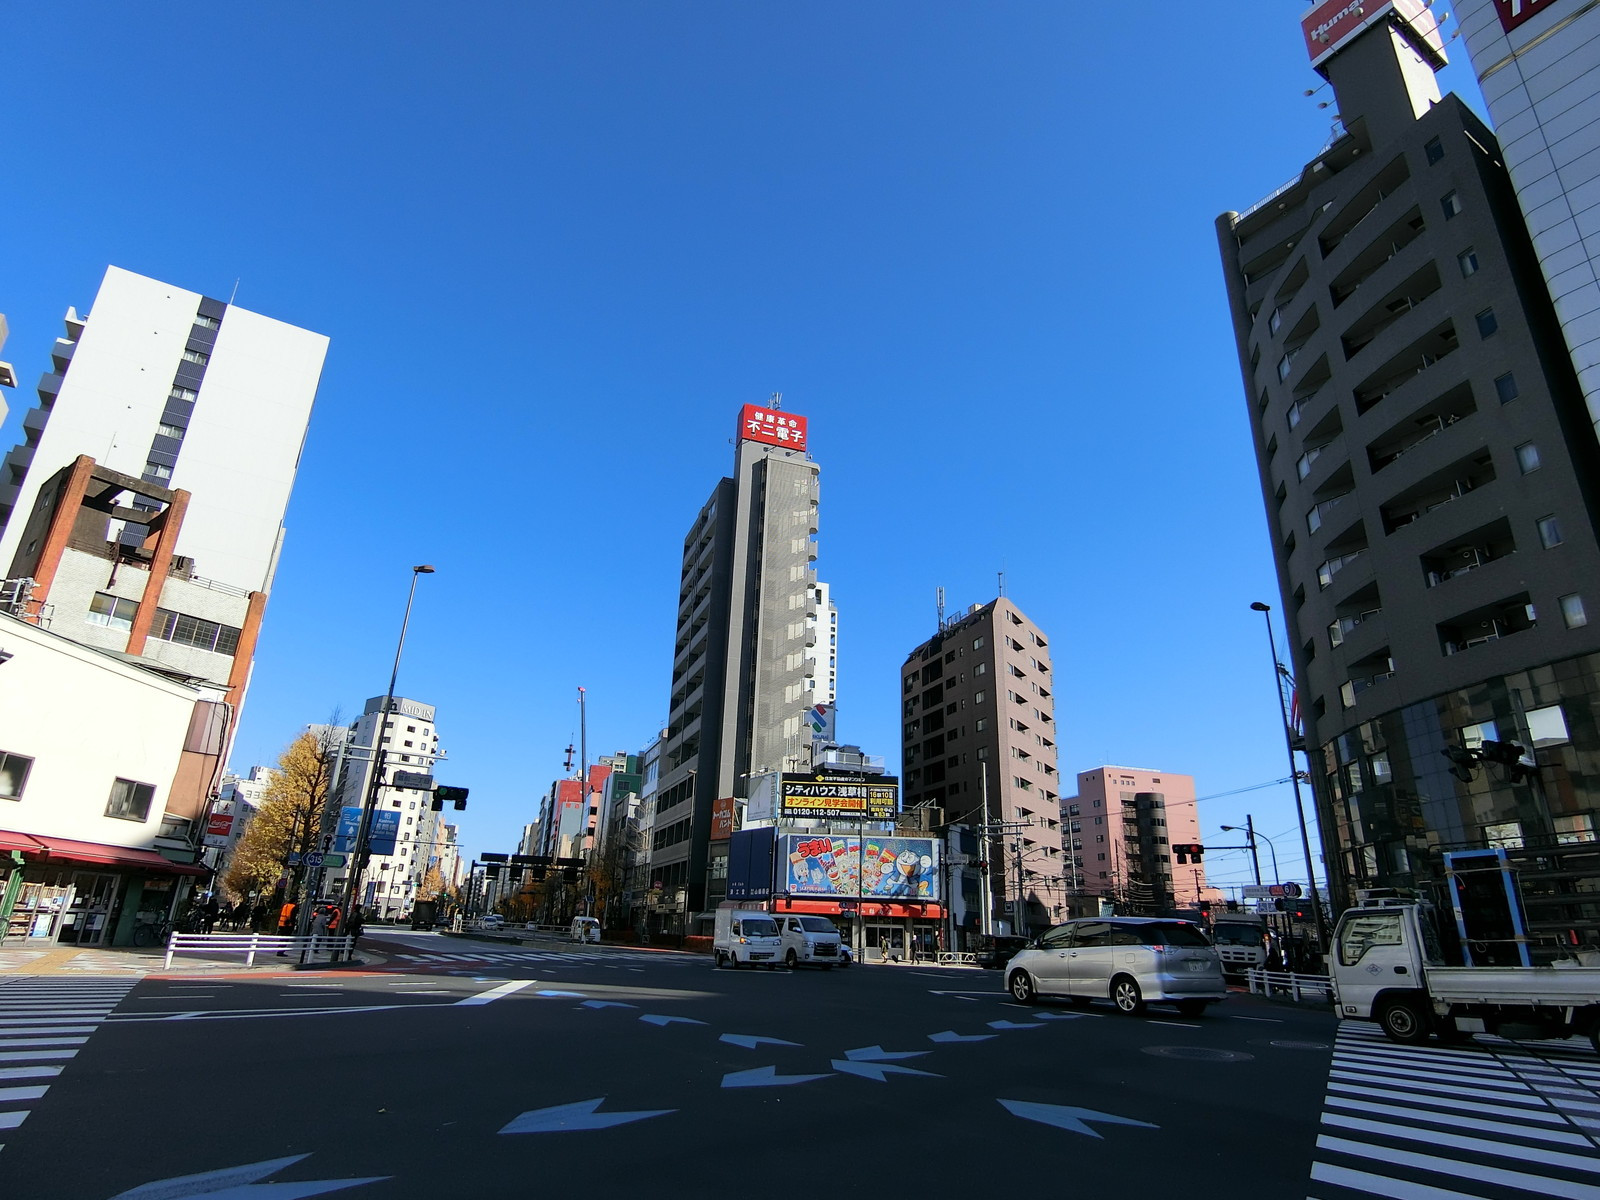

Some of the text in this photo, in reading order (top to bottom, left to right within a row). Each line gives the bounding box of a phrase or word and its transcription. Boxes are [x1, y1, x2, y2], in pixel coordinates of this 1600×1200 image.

[754, 411, 798, 428] 健康革命
[746, 419, 804, 443] 不二電子
[401, 704, 433, 719] MID IN
[786, 797, 866, 808] オンライン見学会開催
[792, 808, 840, 817] 0120-112-507
[797, 837, 833, 858] うまい
[309, 854, 323, 864] 315
[1284, 885, 1290, 894] 6
